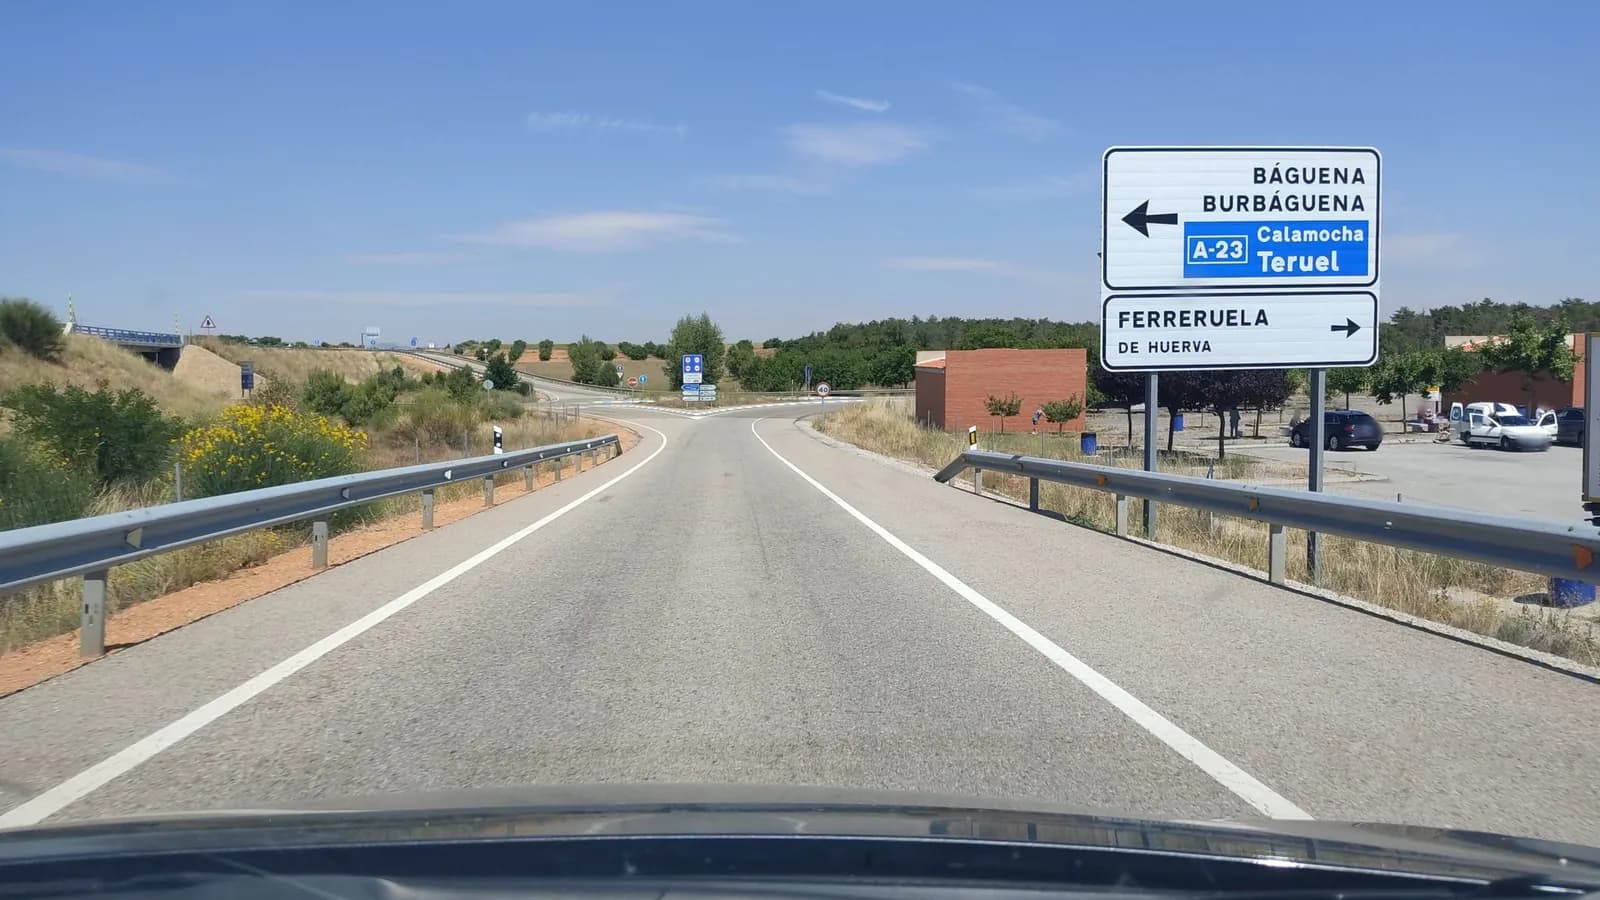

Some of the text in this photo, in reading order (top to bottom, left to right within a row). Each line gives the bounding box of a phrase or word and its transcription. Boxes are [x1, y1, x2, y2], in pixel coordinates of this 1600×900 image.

[1253, 162, 1365, 185] BÁGUENA
[1203, 190, 1365, 212] BURBÁGUENA
[1256, 226, 1364, 243] Calamocha
[1192, 240, 1244, 259] A-23
[1256, 250, 1340, 273] Teruel
[1118, 309, 1269, 329] FERRERUELA
[1118, 340, 1212, 354] DE HUERVA
